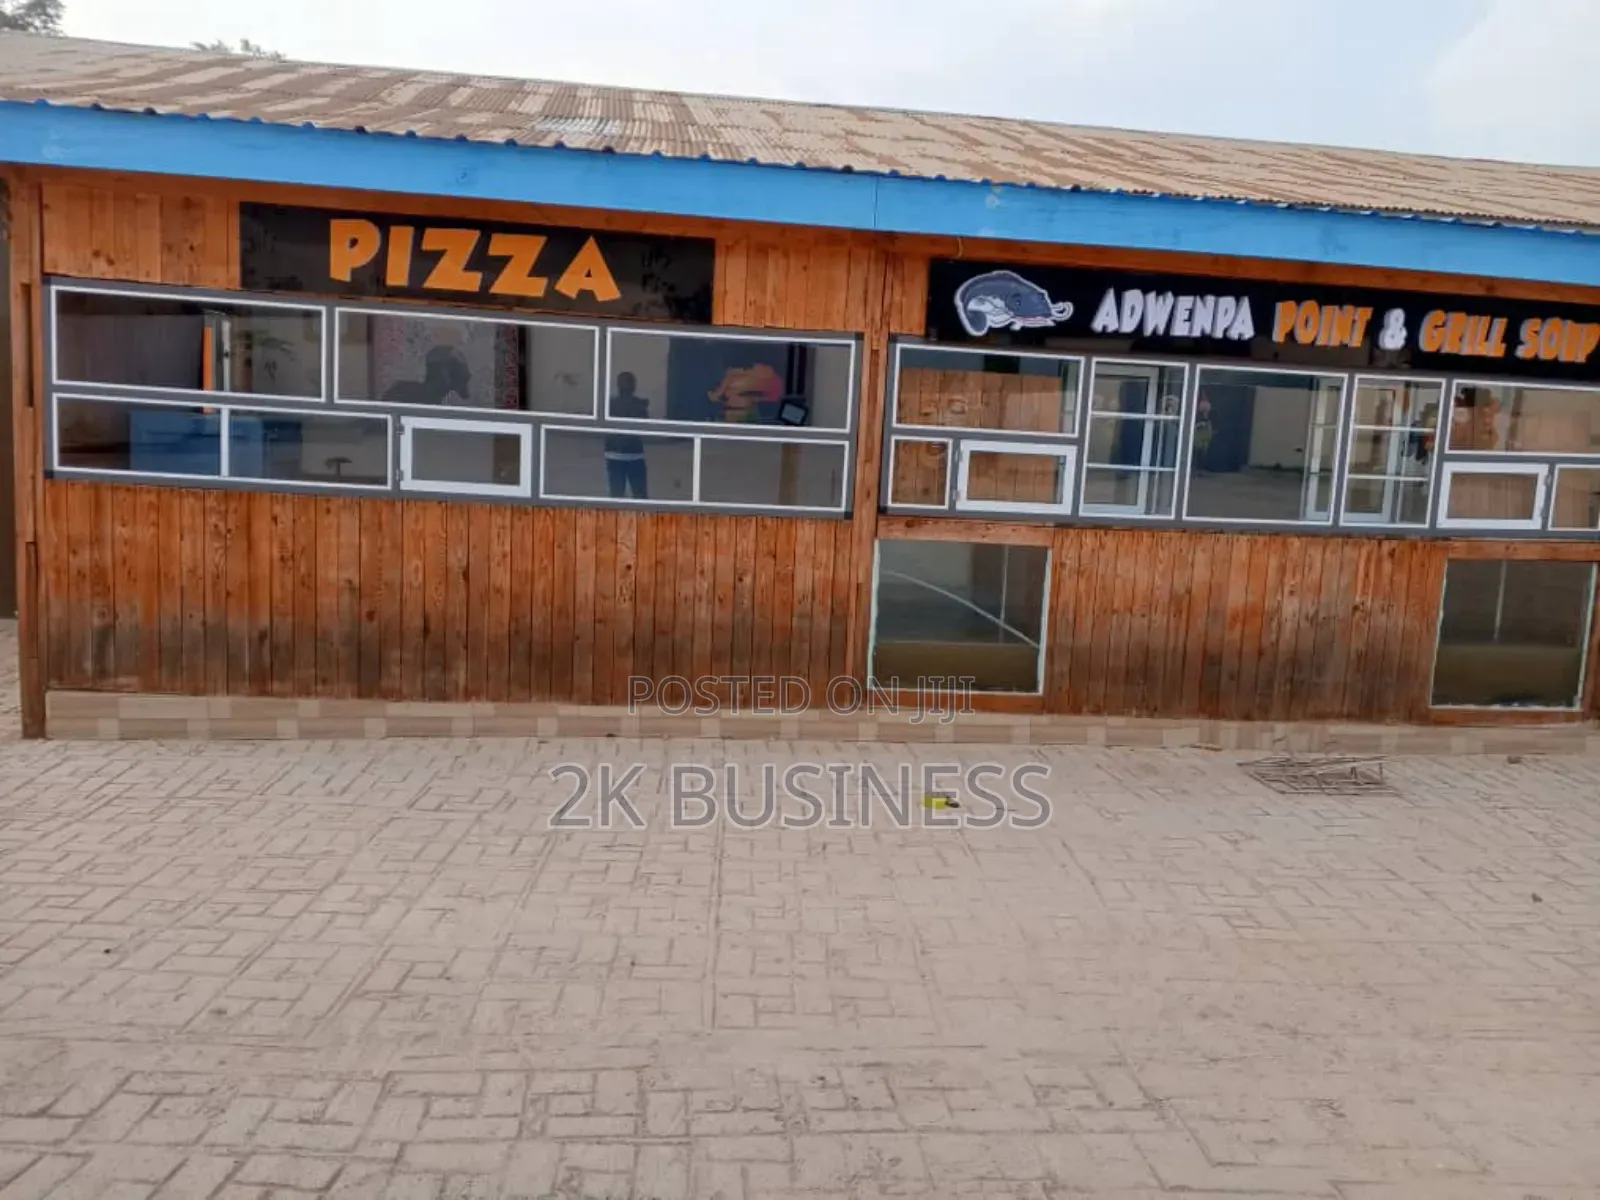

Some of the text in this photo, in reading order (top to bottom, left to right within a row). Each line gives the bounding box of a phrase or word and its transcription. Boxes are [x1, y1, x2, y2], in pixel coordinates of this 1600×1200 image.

[330, 218, 622, 302] PIZZA
[1091, 287, 1600, 363] ADWENPA POINT & GRILL SOUP
